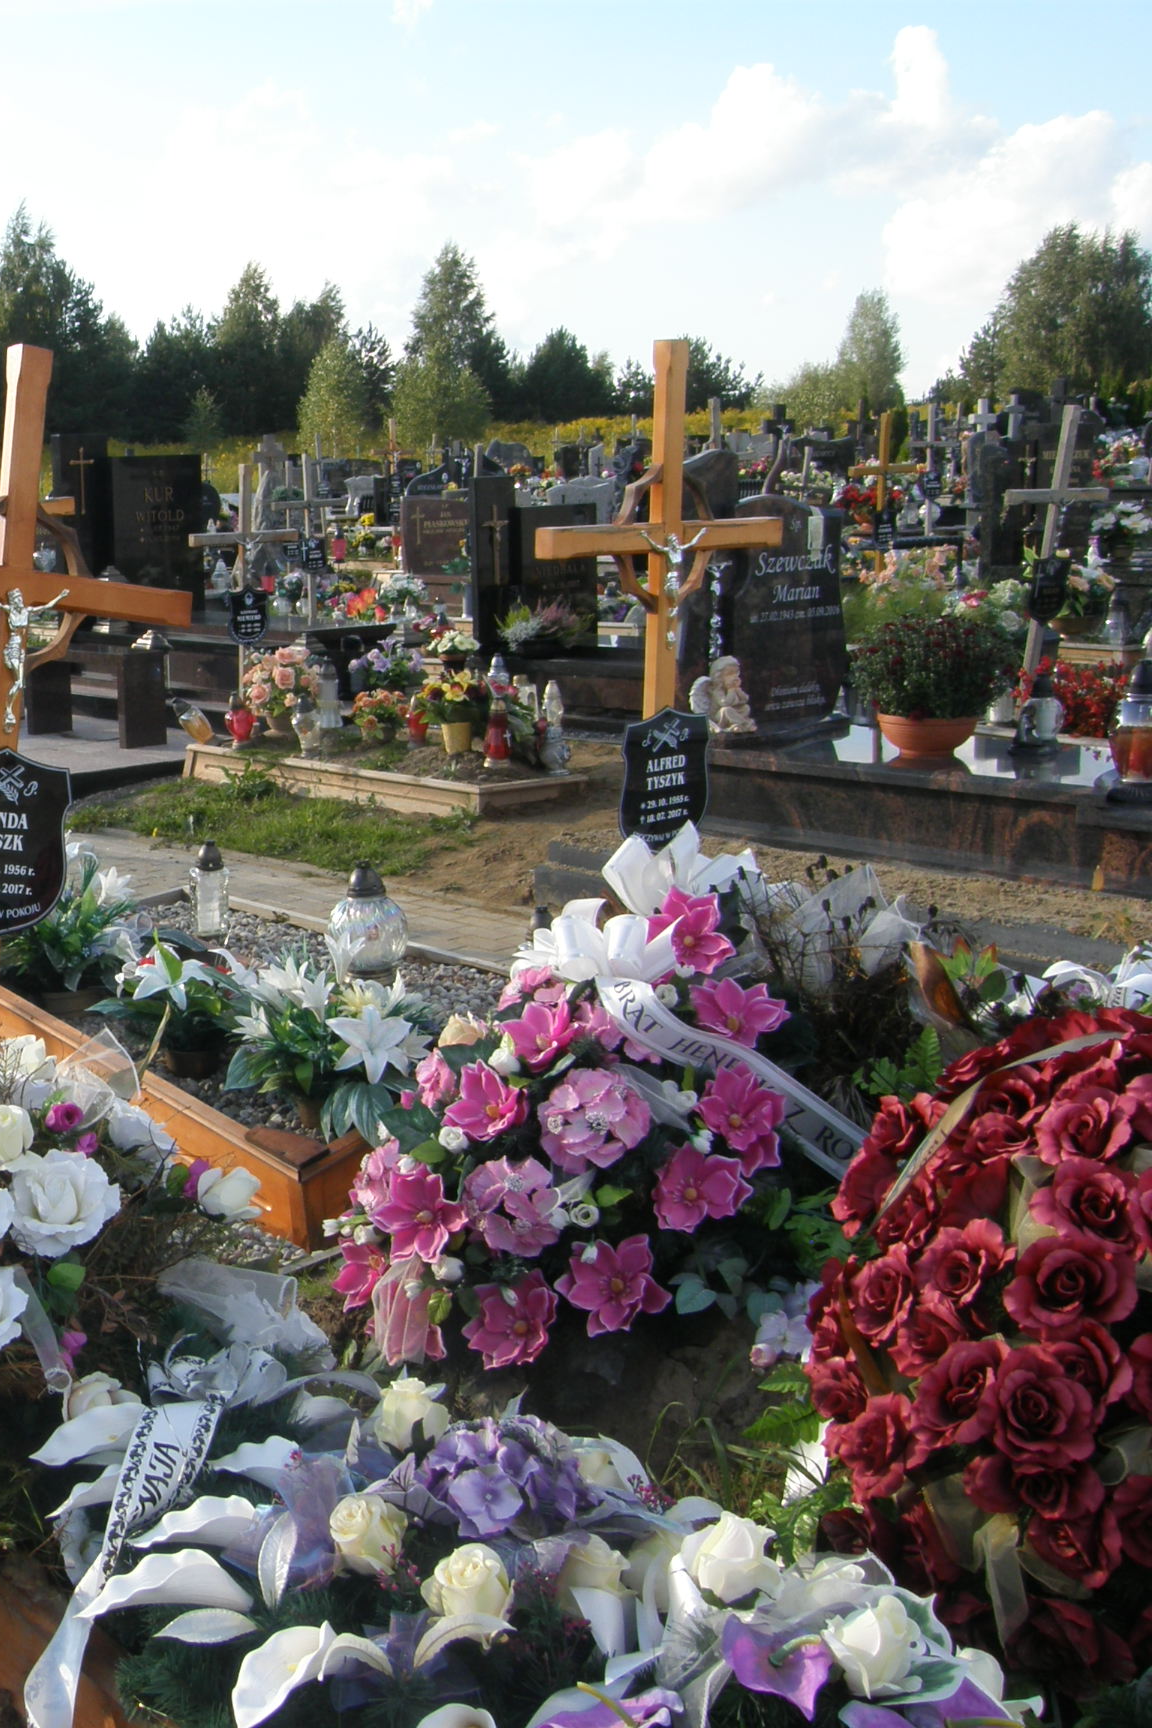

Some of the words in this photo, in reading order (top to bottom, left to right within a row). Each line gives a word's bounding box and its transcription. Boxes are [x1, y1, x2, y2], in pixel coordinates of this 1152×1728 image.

[143, 487, 174, 503] KUR
[135, 509, 185, 523] WITOLD
[754, 544, 837, 577] Szewczak
[772, 581, 820, 604] Marian
[646, 754, 687, 773] ALFRED
[646, 772, 686, 791] TYSZYK
[3, 864, 27, 876] 1956
[5, 902, 42, 919] POKOJU
[613, 980, 665, 1033] BRAT
